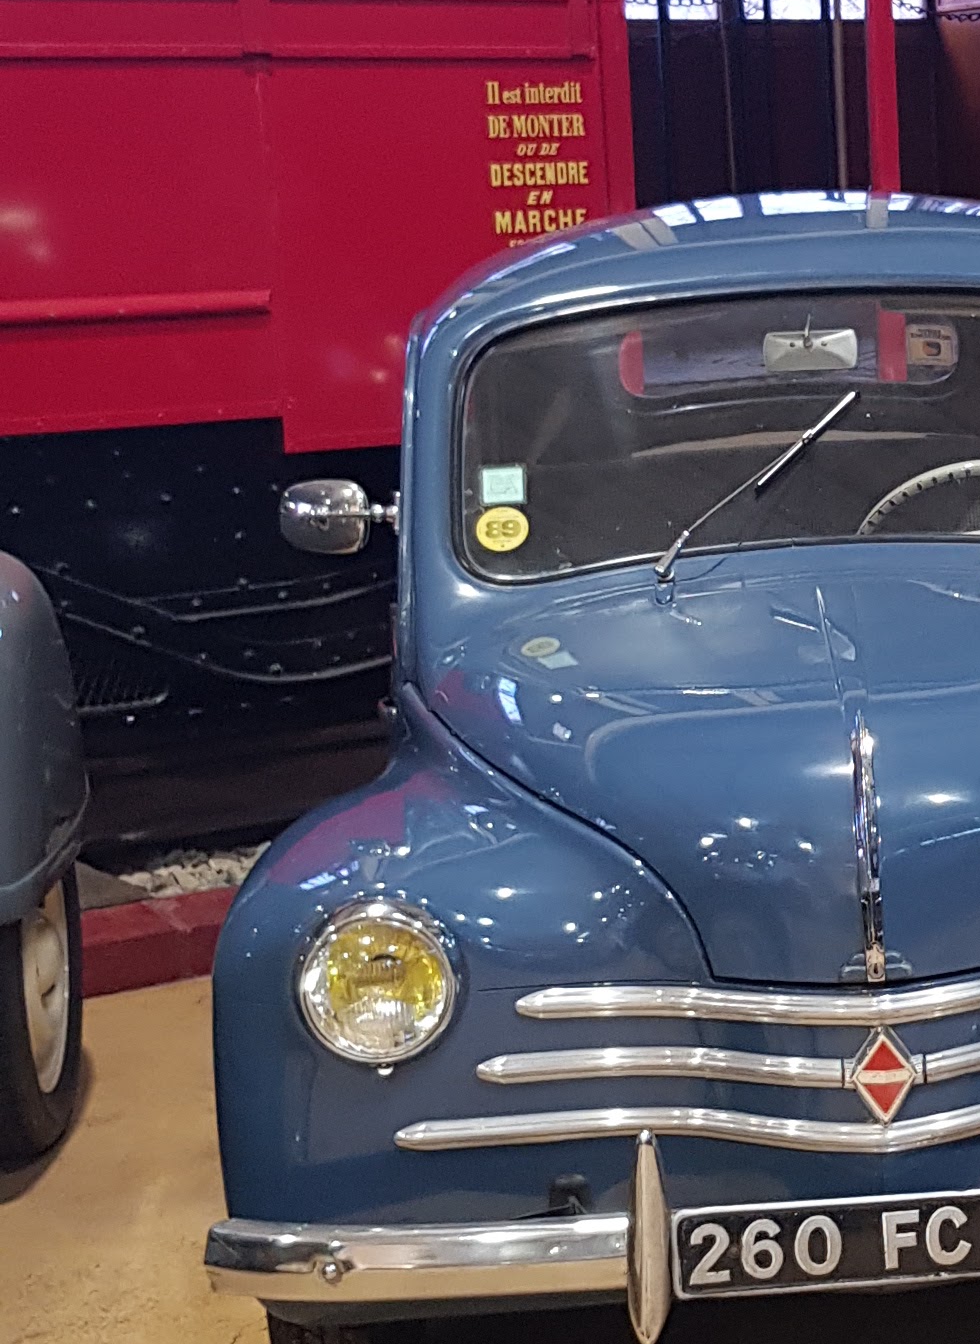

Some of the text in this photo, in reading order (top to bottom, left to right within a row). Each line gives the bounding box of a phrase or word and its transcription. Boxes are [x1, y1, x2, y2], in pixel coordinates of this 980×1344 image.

[503, 88, 521, 104] est
[525, 81, 583, 104] interdit
[488, 114, 586, 138] DE MONTER
[517, 143, 560, 156] OU DE
[490, 161, 589, 187] DESCENDRE
[527, 190, 553, 205] EN
[495, 208, 587, 234] MARCHE
[688, 1217, 843, 1286] 260
[882, 1204, 973, 1271] FC
